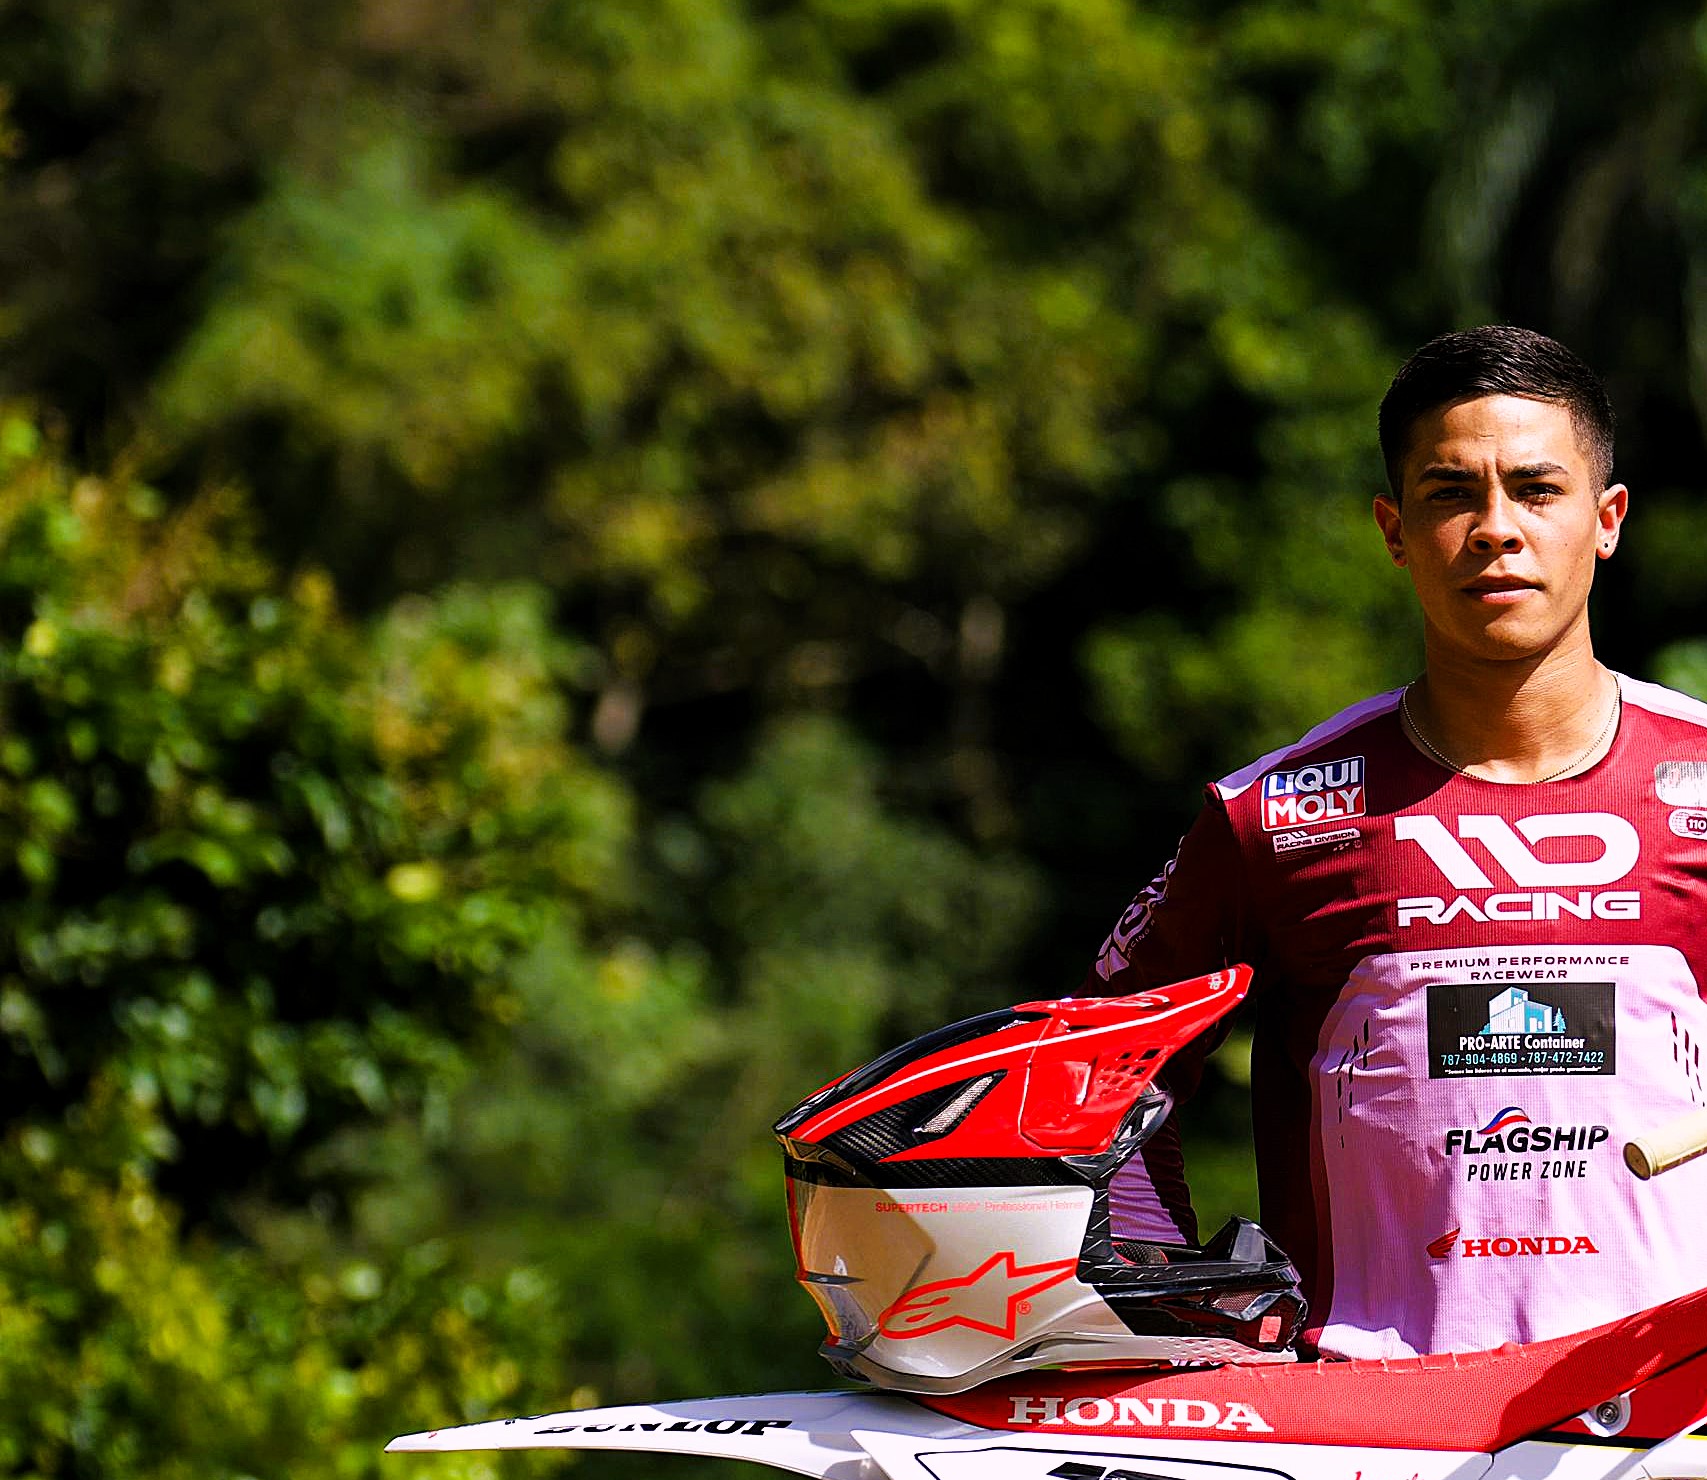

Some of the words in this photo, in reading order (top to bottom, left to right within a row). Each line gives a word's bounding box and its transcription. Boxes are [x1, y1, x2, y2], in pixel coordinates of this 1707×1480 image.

[1268, 760, 1359, 796] LIQUI
[1268, 786, 1361, 826] MOLY
[1394, 812, 1641, 890] 110
[1397, 890, 1641, 927] RACING
[1410, 957, 1490, 971] PREMIUM
[1498, 956, 1630, 966] PERFORMANCE
[1470, 970, 1568, 981] RACEWEAR
[1459, 1035, 1521, 1051] PRO-ARTE
[1524, 1034, 1585, 1050] Container
[1441, 1052, 1518, 1066] 787-904-4869
[1526, 1051, 1604, 1064] 787-472-7422
[1445, 1125, 1609, 1155] FLAGSHIP
[1467, 1162, 1532, 1181] POWER
[1540, 1160, 1587, 1179] ZONE
[875, 1201, 947, 1213] SUPERTECH
[1462, 1236, 1599, 1257] HONDA
[1007, 1396, 1274, 1432] HONDA
